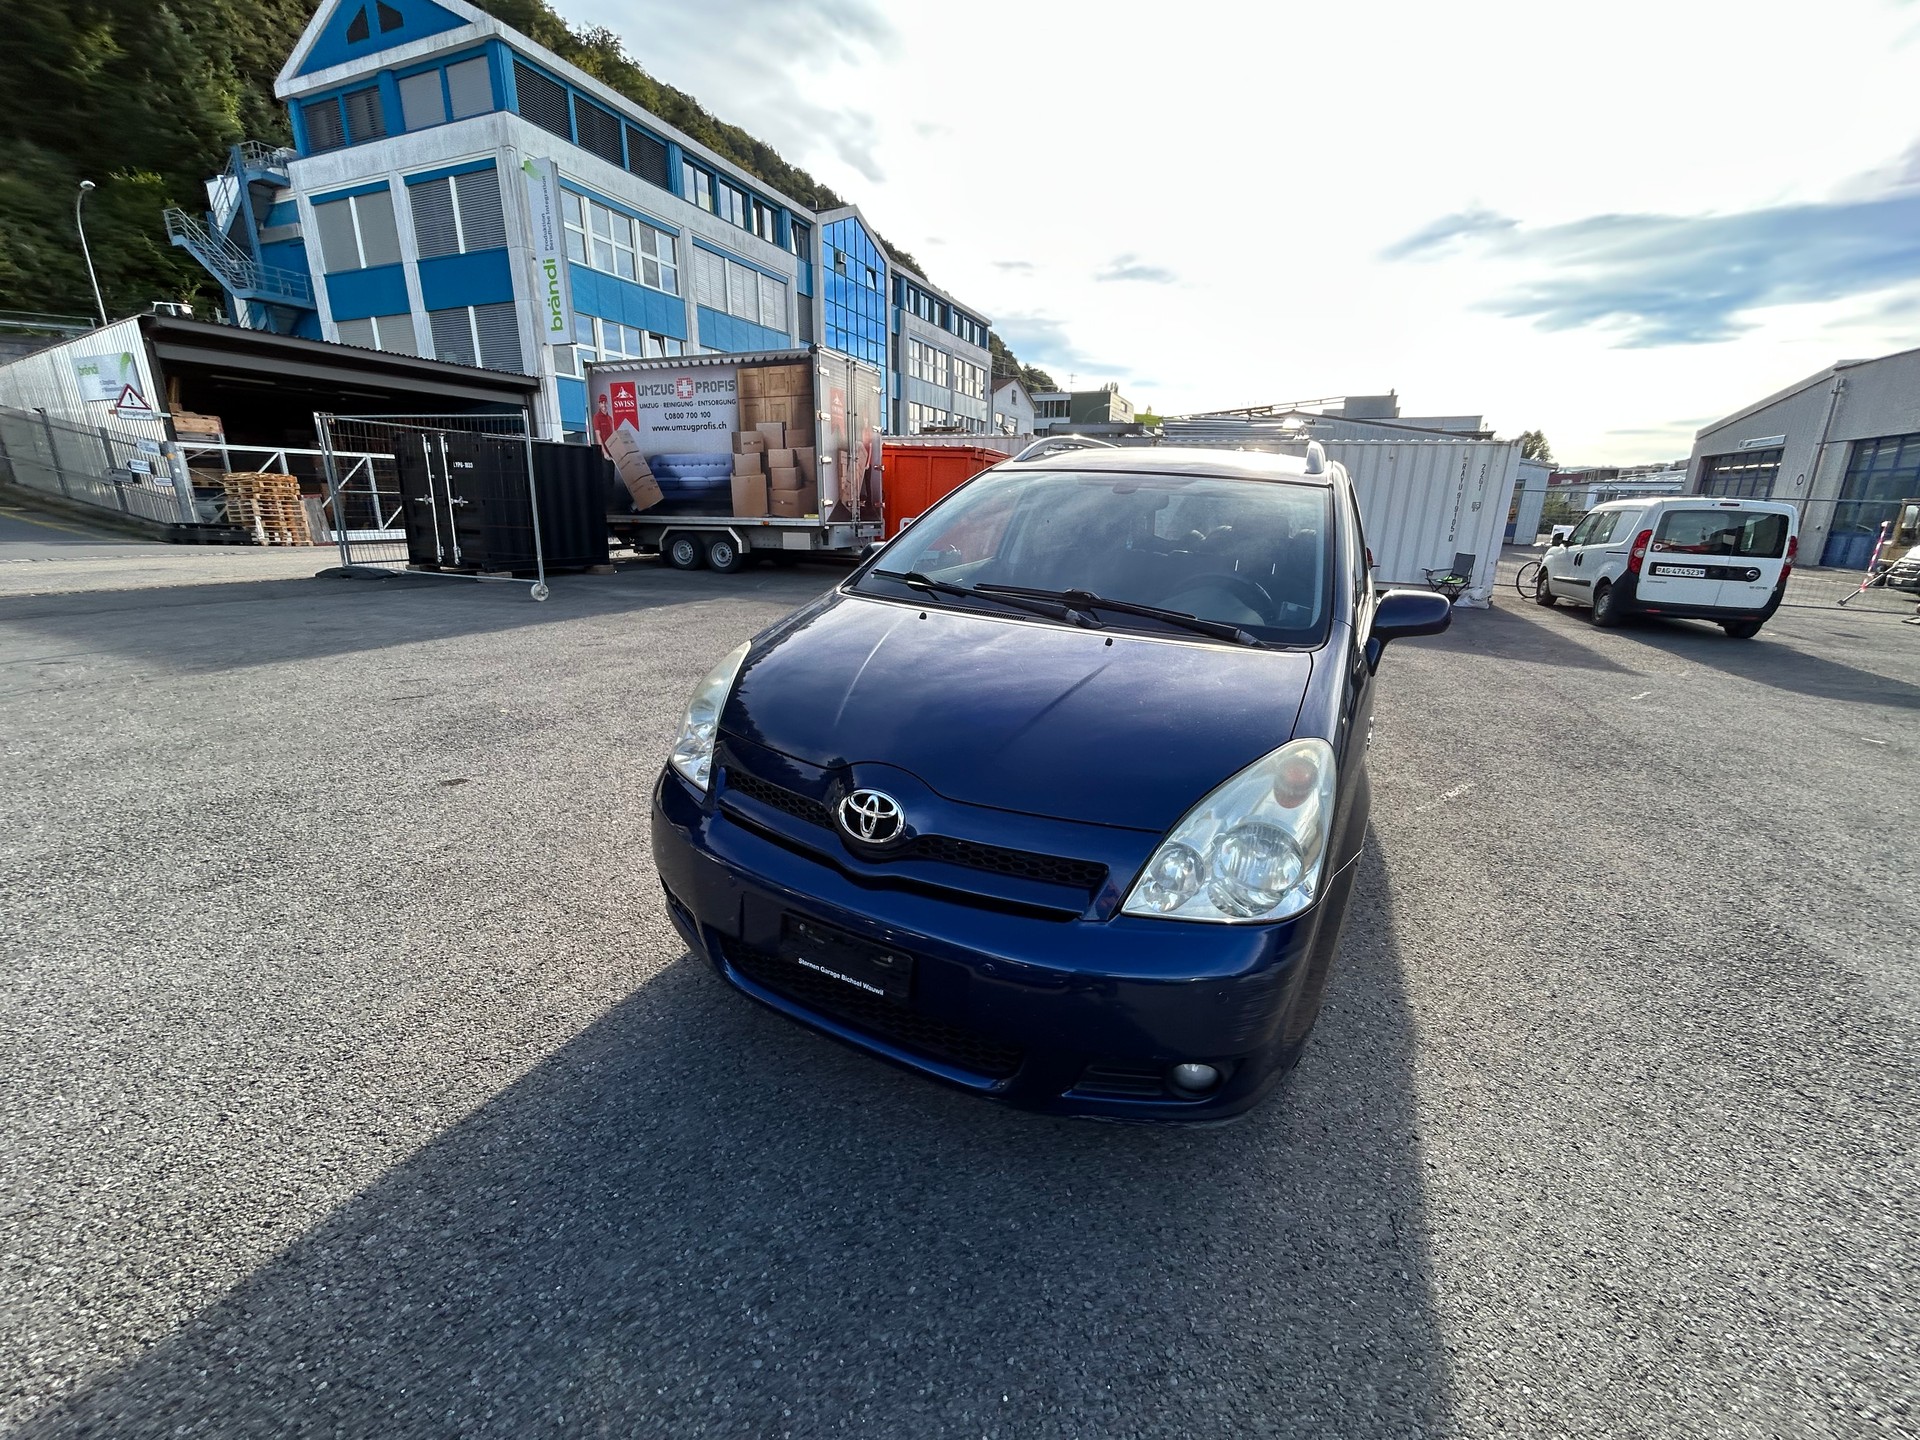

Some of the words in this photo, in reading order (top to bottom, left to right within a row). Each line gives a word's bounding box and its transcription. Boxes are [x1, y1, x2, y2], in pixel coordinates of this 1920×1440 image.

[542, 176, 550, 215] Integration
[543, 258, 564, 332] brändi
[638, 384, 675, 397] UMZUG
[695, 380, 736, 393] PROFIS
[652, 421, 727, 432] www.umzugprofis.ch
[820, 966, 841, 979] Garage
[862, 982, 884, 995] Wauwil
